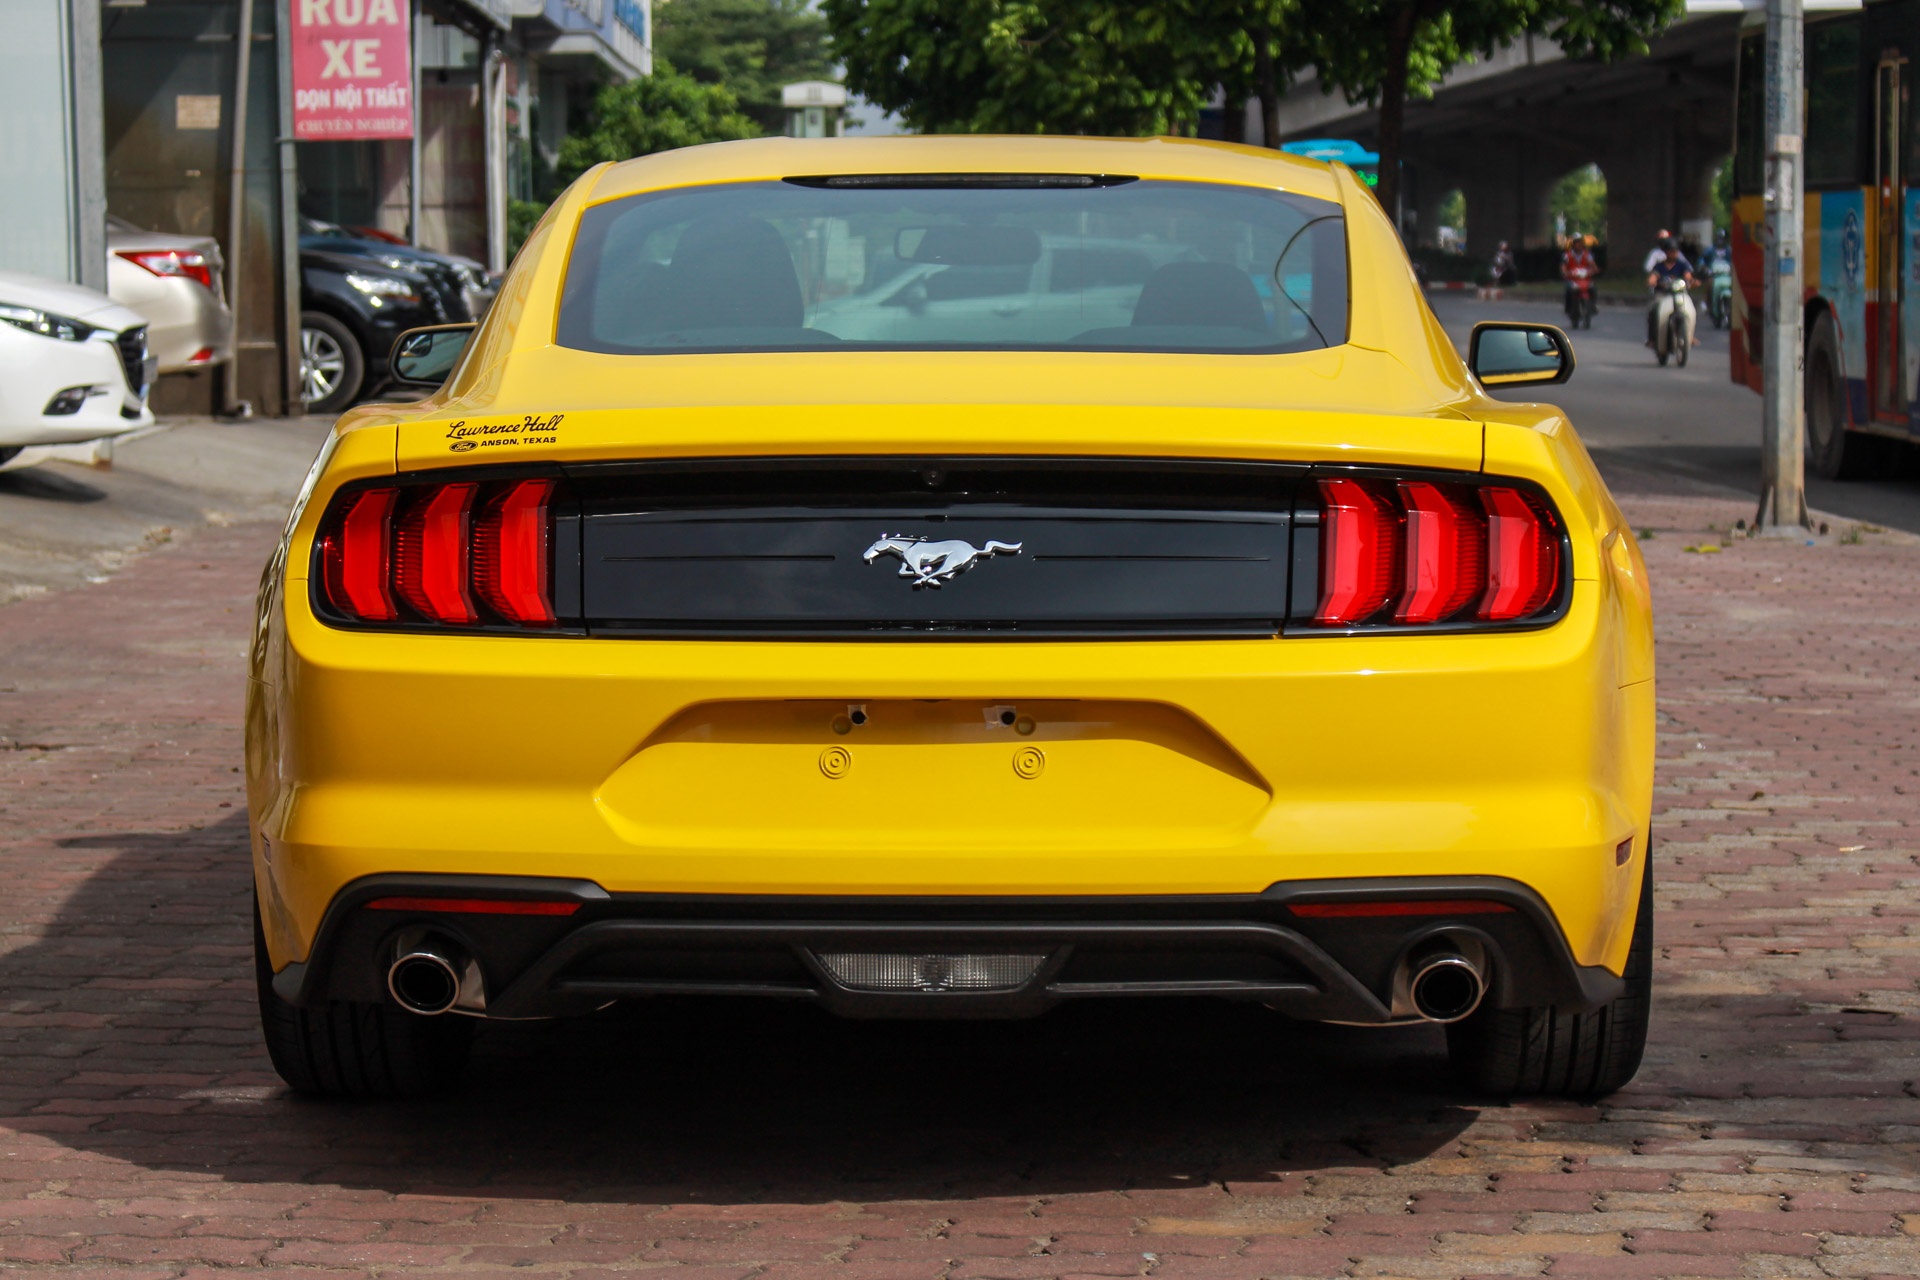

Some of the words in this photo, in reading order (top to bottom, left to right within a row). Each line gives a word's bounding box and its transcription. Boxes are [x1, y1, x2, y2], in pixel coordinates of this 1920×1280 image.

[321, 38, 382, 78] XE
[296, 88, 331, 113] DỌN
[333, 82, 363, 113] NỘI
[365, 80, 407, 108] THẤT
[446, 420, 521, 440] Lawrence
[520, 414, 565, 433] Hall
[480, 438, 520, 447] ANSON,
[523, 436, 557, 445] TEXAS
